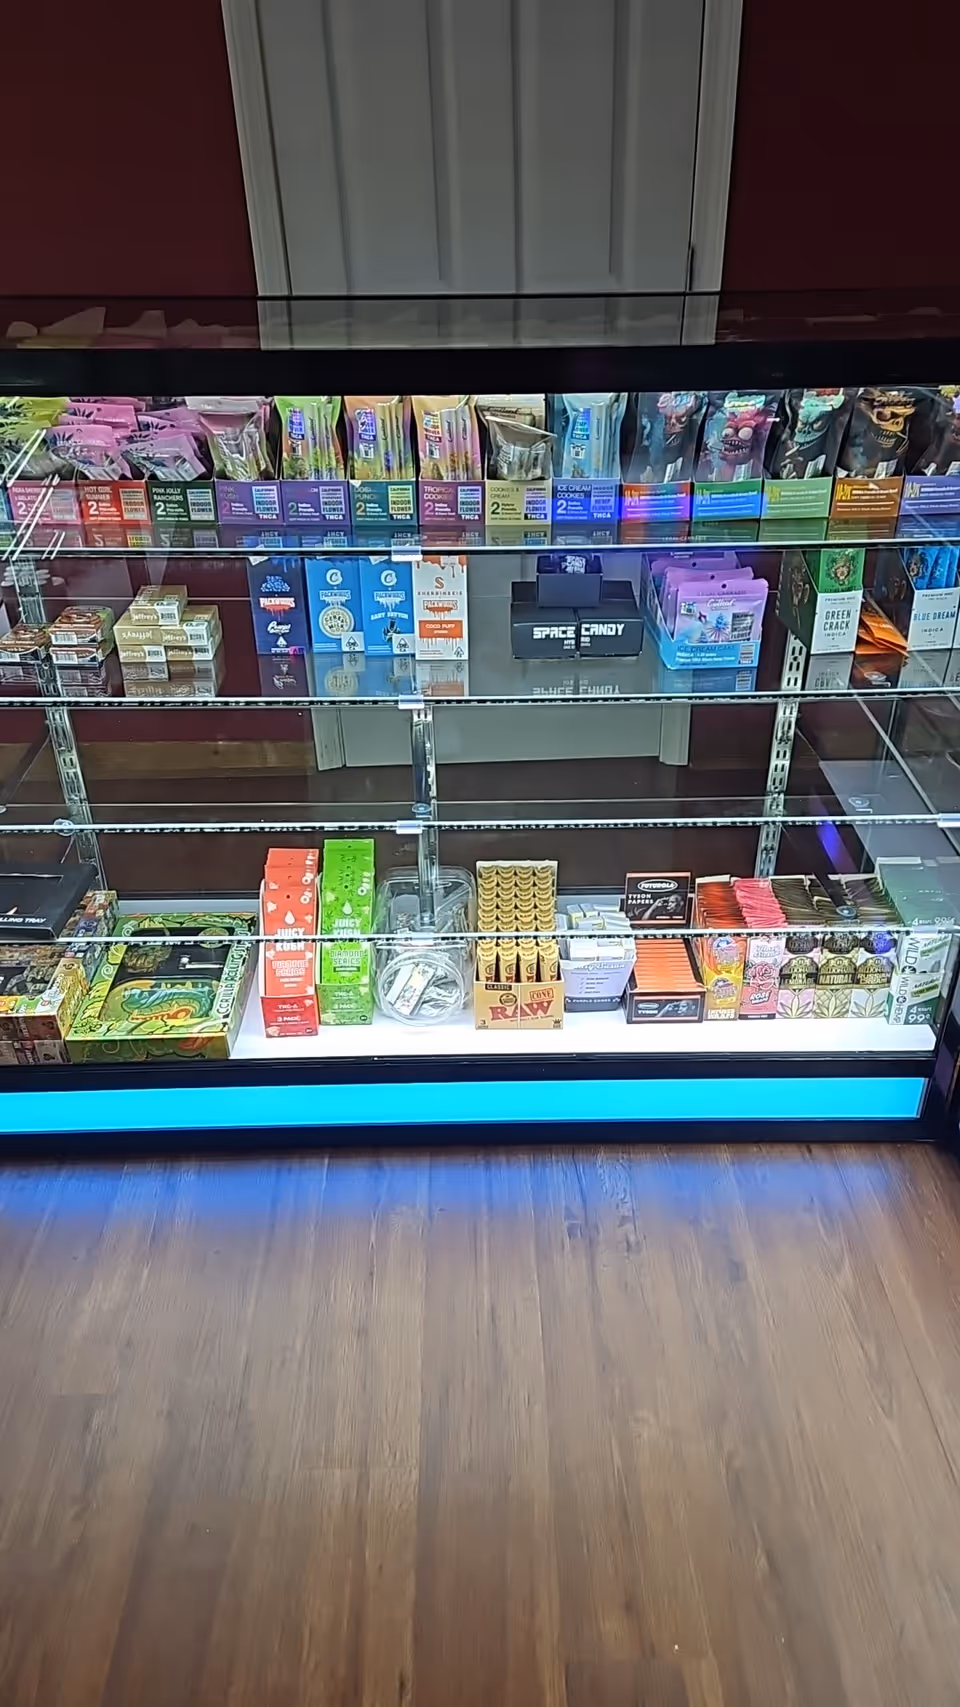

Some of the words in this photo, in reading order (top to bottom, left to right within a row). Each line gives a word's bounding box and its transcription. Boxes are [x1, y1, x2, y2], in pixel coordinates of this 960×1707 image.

[17, 501, 28, 515] 2
[88, 501, 99, 515] 2
[155, 502, 166, 515] 2
[221, 501, 230, 514] 2
[288, 502, 297, 514] 2
[356, 502, 365, 515] 2
[424, 502, 434, 515] 2
[490, 501, 500, 515] 2
[557, 500, 567, 514] 2
[435, 577, 445, 589] S
[825, 609, 851, 620] GREEN
[914, 612, 930, 621] BLUE
[933, 610, 956, 620] DREAM
[533, 626, 576, 639] SPACE
[581, 624, 625, 636] CANDY
[823, 620, 851, 631] CRACK
[334, 919, 361, 928] JUICY
[275, 927, 305, 936] JUICY
[275, 942, 305, 951] KUSH
[904, 937, 921, 965] WILD
[330, 950, 364, 958] DIAMOND
[819, 973, 853, 984] NATURAL
[898, 976, 910, 995] WILD
[532, 991, 551, 1000] CONE
[489, 1000, 554, 1021] RAW
